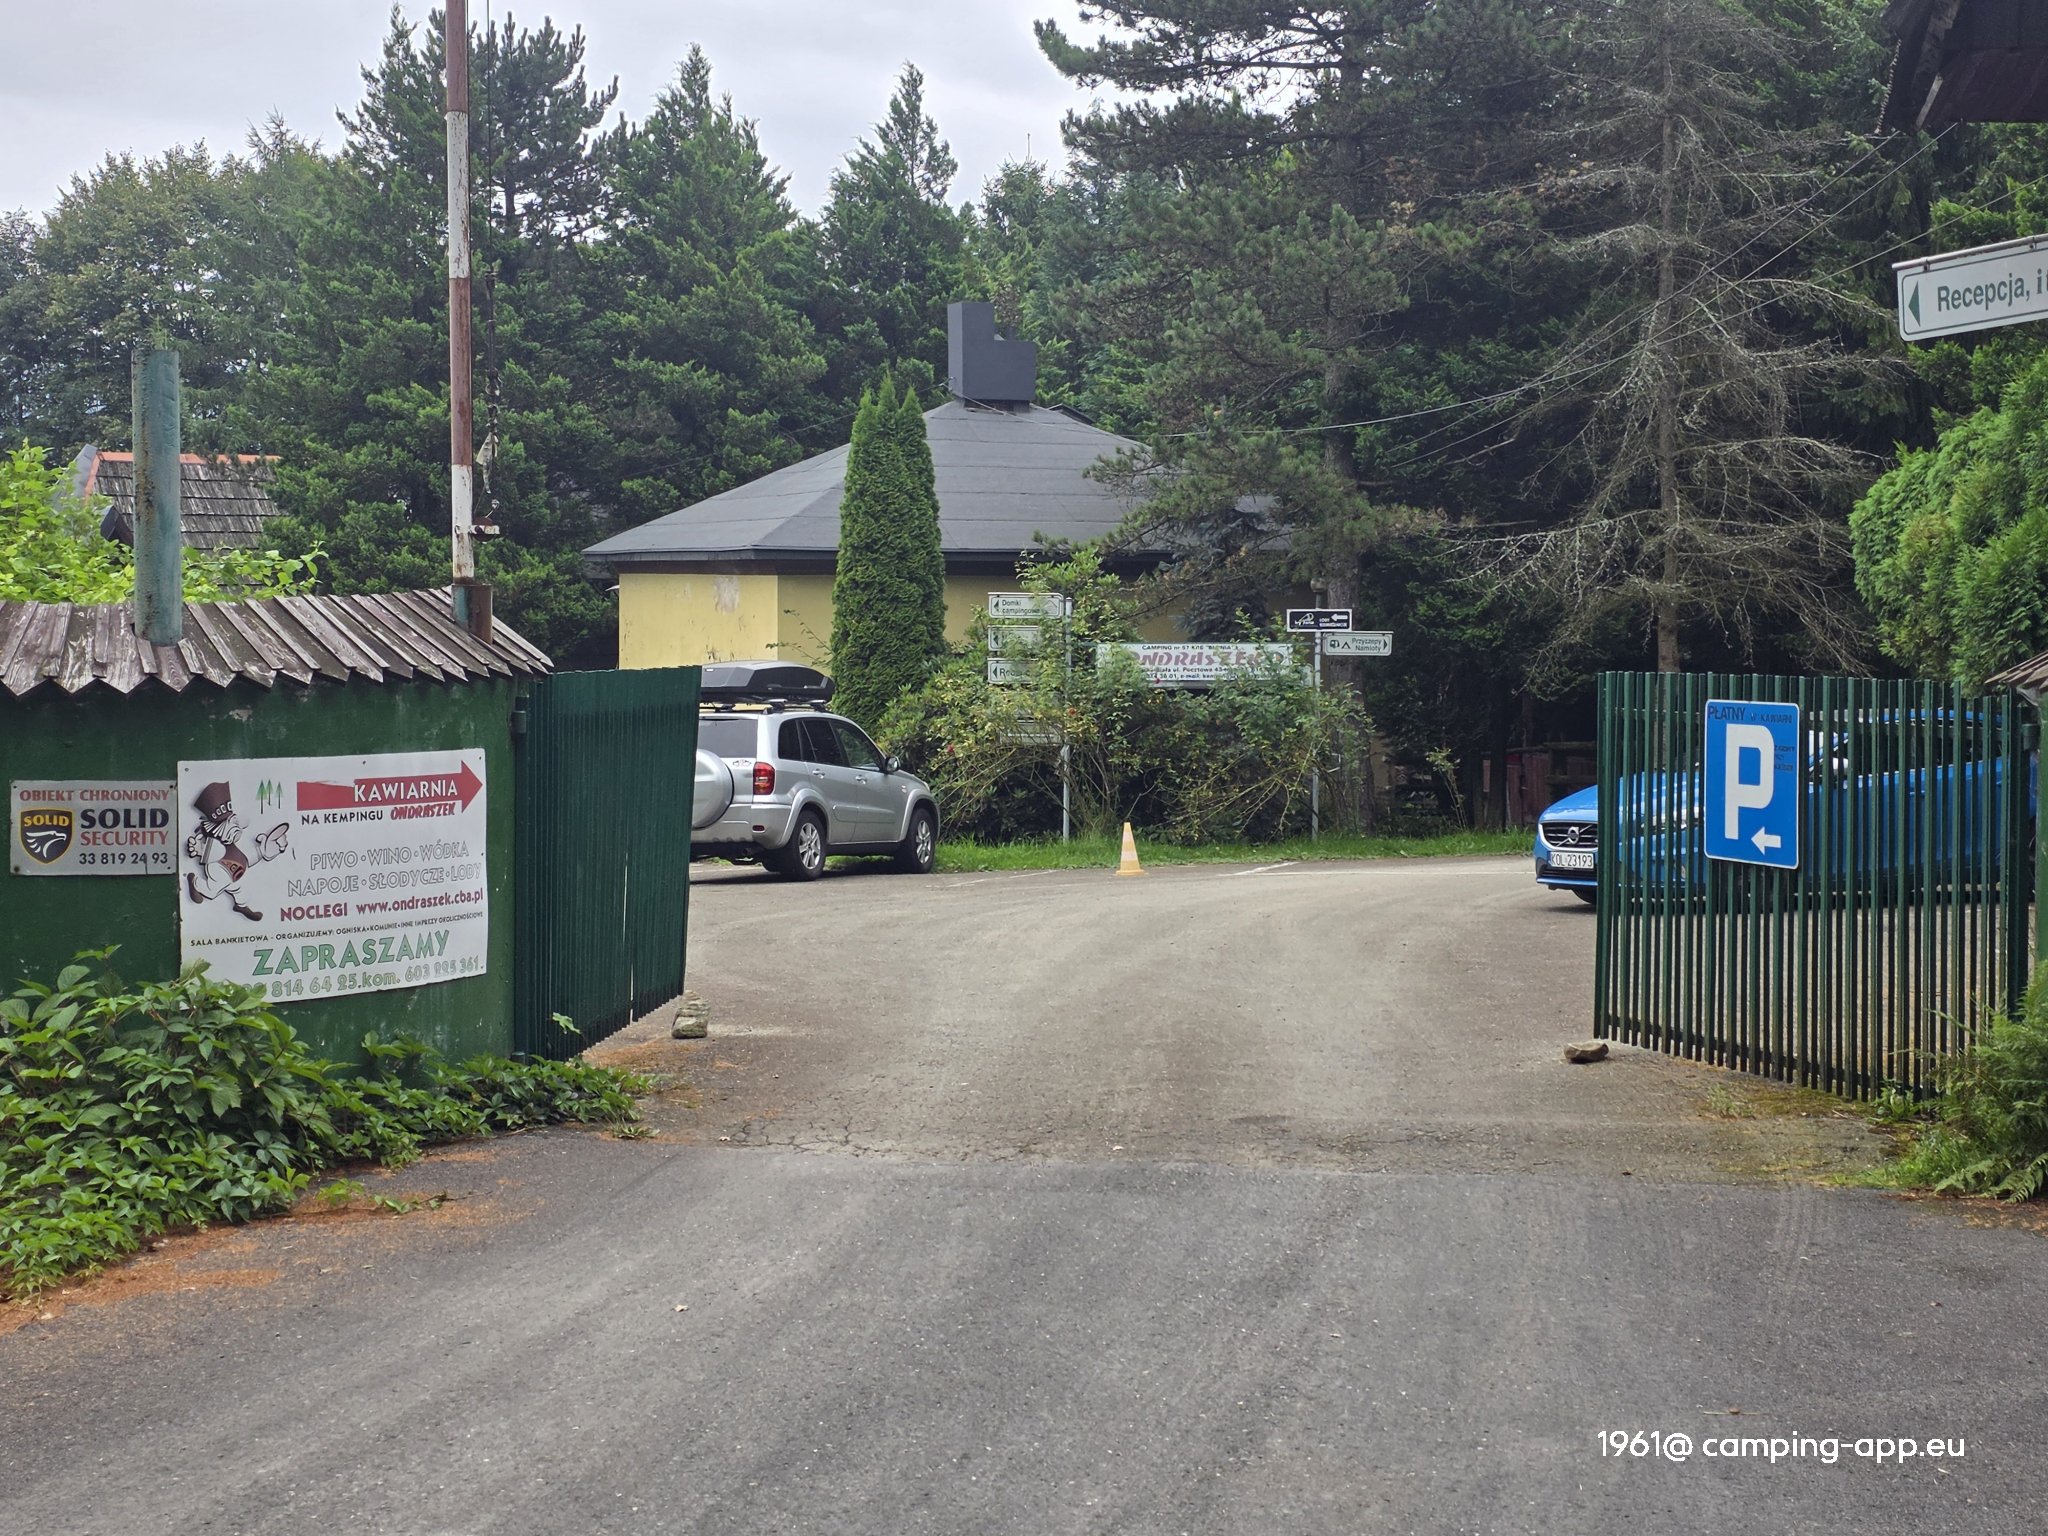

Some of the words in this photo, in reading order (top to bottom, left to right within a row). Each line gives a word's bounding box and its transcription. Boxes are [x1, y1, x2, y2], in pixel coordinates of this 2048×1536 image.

[1937, 272, 2030, 312] Recepcja,
[1352, 638, 1381, 646] Przyczepy
[1708, 705, 1745, 720] PŁATNY
[354, 780, 458, 802] KAWIARNIA
[1724, 723, 1774, 840] P
[20, 790, 74, 800] OBIEKT
[80, 790, 169, 800] CHRONIONY
[24, 814, 70, 827] SOLID
[80, 808, 169, 829] SOLID
[301, 814, 320, 826] NA
[324, 810, 383, 824] KEMPINGU
[390, 802, 456, 820] ONDRASZEK
[80, 831, 169, 846] SECURITY
[79, 853, 96, 864] 33
[101, 853, 126, 864] 819
[131, 853, 148, 864] 24
[152, 853, 168, 864] 93
[310, 850, 358, 870] PIWO
[367, 847, 412, 866] WINO
[419, 839, 469, 862] WÓDKA
[1568, 854, 1592, 867] 23193
[288, 874, 359, 897] NAPOJE
[368, 867, 444, 890] SŁODYCZE
[450, 862, 481, 882] LODY
[280, 902, 348, 922] NOCLEGI
[356, 888, 484, 916] www.ondraszek.cba.pl
[216, 936, 268, 944] BANKIETOWA
[336, 924, 366, 934] OGNISKA
[370, 922, 398, 931] KOMUNIE
[414, 918, 438, 926] IMPREZY
[252, 930, 450, 976] ZAPRASZAMY
[271, 979, 304, 998] 814
[309, 976, 332, 993] 64
[404, 964, 430, 982] 603
[434, 961, 457, 978] 225
